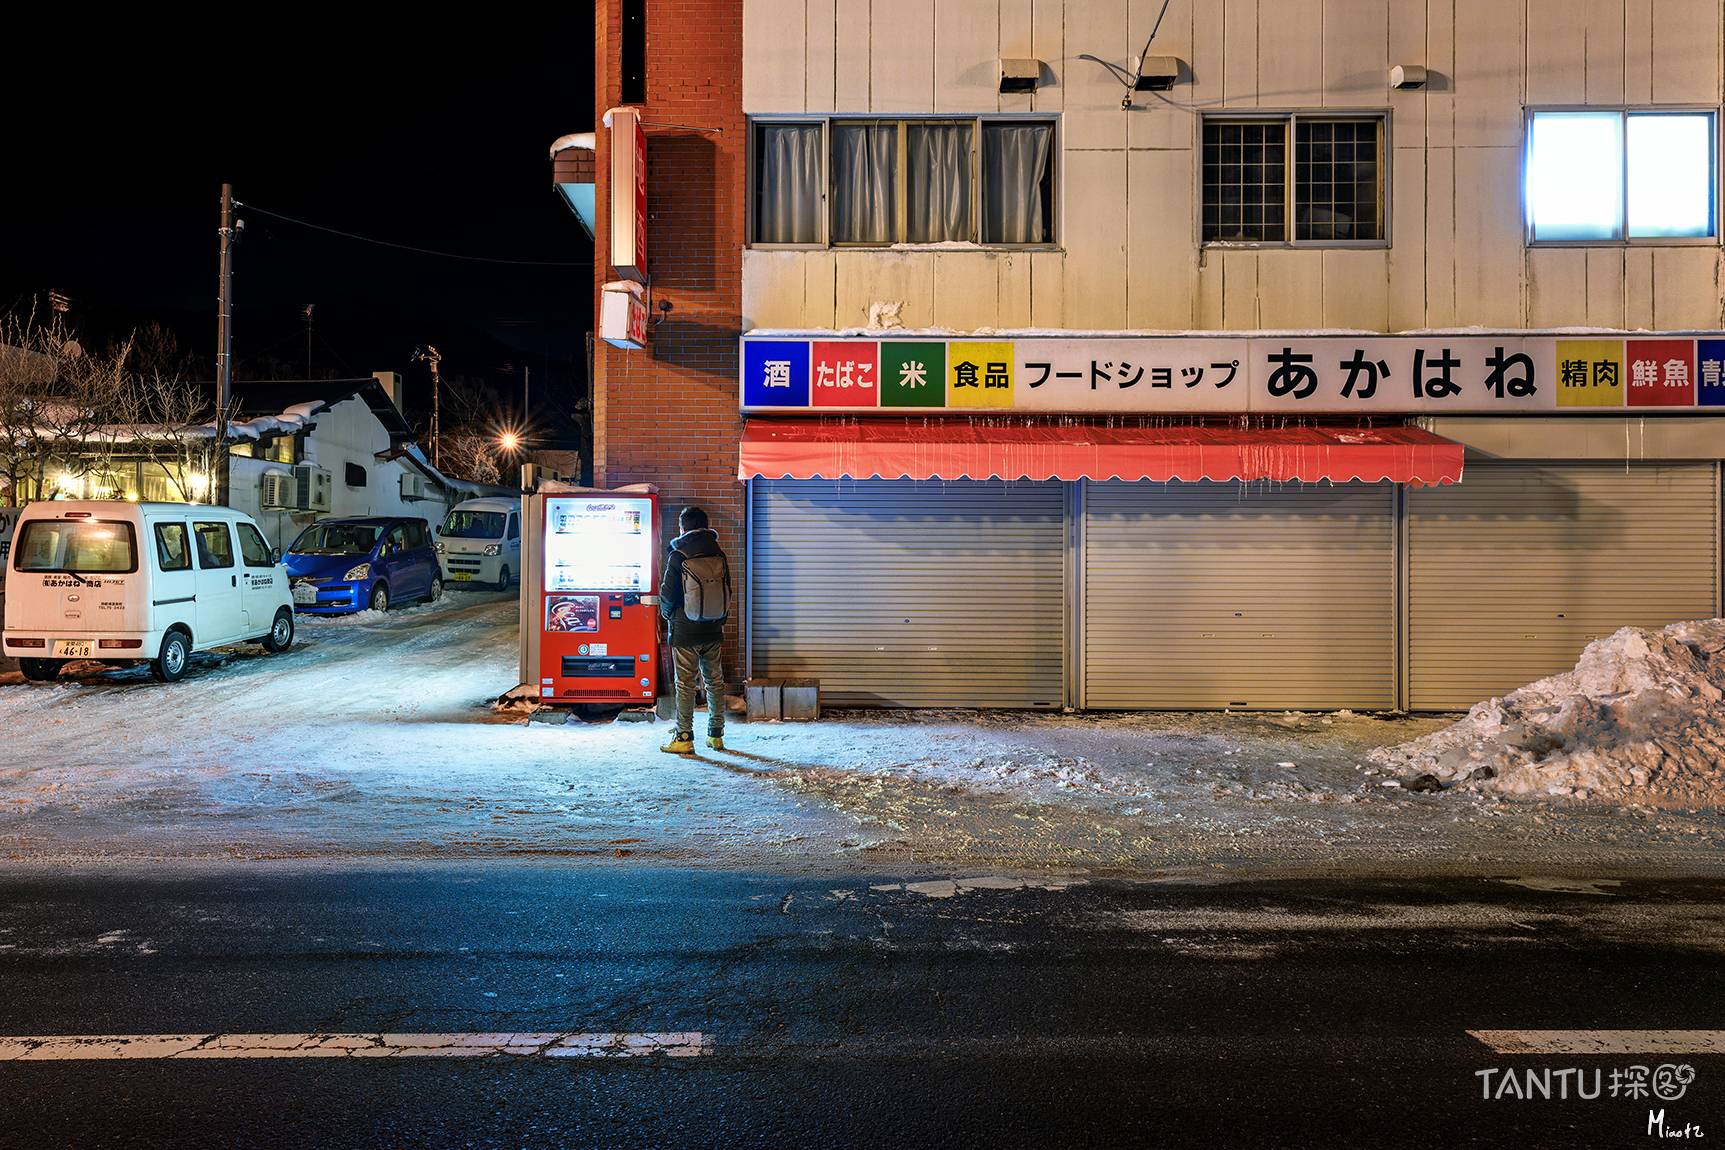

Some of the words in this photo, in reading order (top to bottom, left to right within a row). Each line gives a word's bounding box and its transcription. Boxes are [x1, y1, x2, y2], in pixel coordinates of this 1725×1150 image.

[763, 360, 791, 387] 酒
[816, 361, 873, 388] たばこ
[899, 362, 927, 389] 米
[953, 361, 1009, 389] 食品
[1025, 359, 1240, 390] フードショップ
[1267, 347, 1537, 399] あかはね
[1561, 360, 1619, 388] 精肉
[1632, 359, 1690, 387] 鮮魚
[1702, 359, 1725, 387] 青
